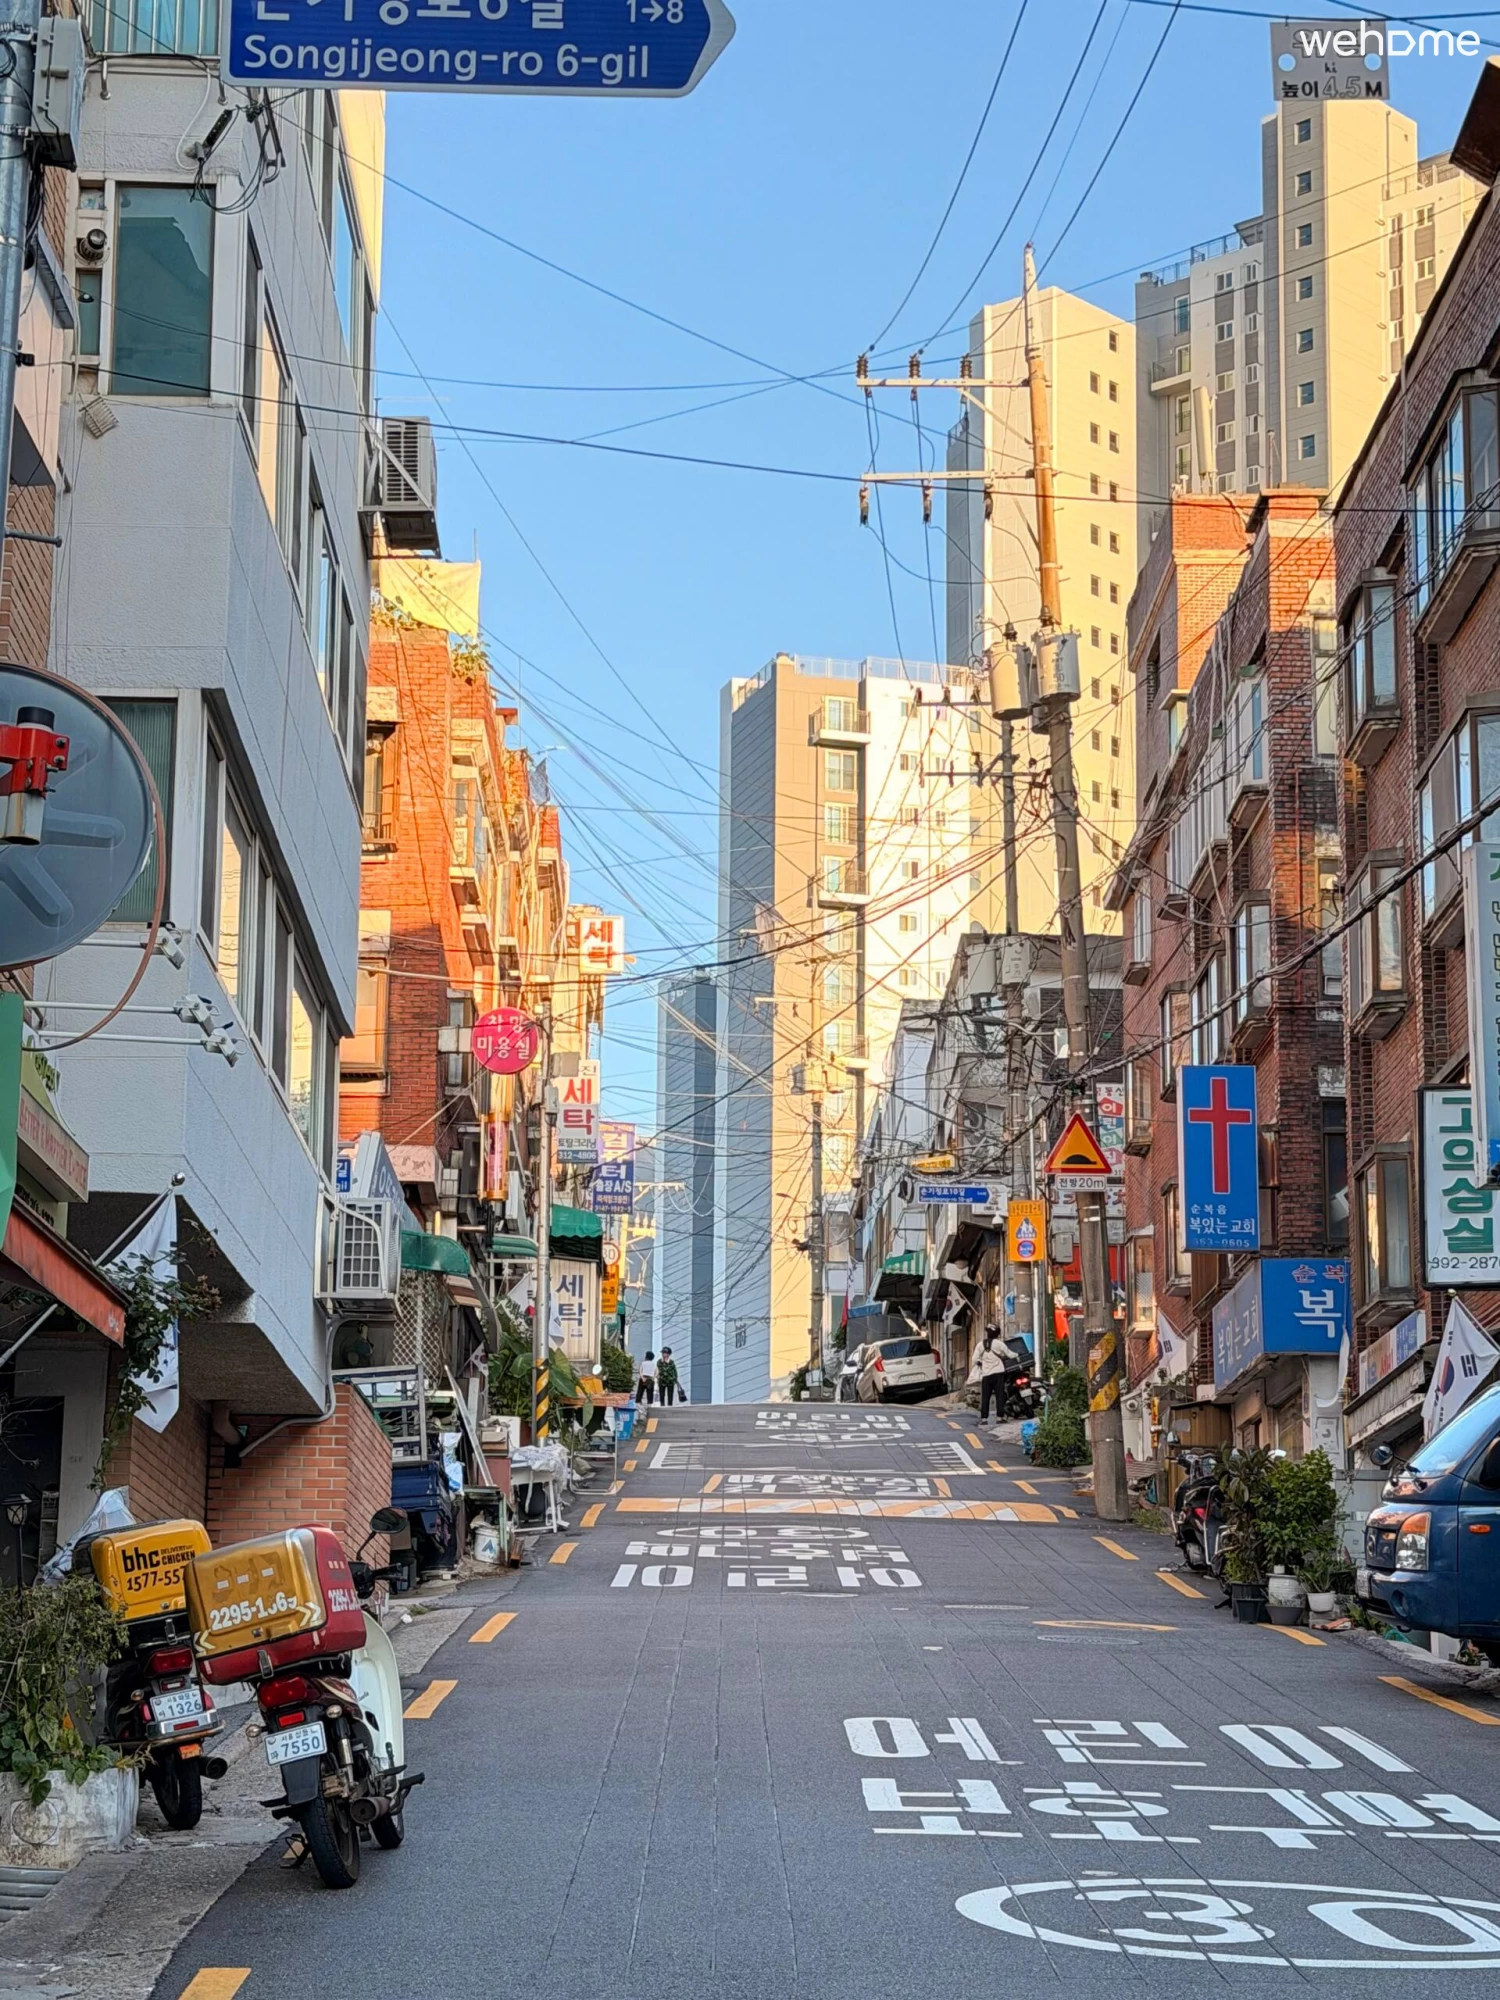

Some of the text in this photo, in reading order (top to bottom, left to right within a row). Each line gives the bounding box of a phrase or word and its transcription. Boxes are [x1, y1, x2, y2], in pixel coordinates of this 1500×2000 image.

[244, 35, 649, 85] Songijeong-ro 6-gil
[1281, 76, 1382, 98] 높이 4.5 M
[583, 920, 617, 969] 세탁
[476, 1035, 531, 1060] 미용실
[562, 1078, 597, 1136] 세탁
[1190, 1203, 1228, 1215] 순복음
[1430, 1256, 1500, 1270] 392-287
[555, 1274, 587, 1327] 세탁
[1293, 1289, 1343, 1339] 복
[121, 1546, 161, 1574] bhc
[161, 1550, 196, 1566] CHICKEN
[625, 1541, 912, 1562] 보호구역
[611, 1563, 923, 1588] 어린이
[168, 1699, 202, 1717] 1326
[280, 1735, 321, 1758] 7550
[843, 1716, 1420, 1773] 어린이
[860, 1777, 1500, 1849] 보호구역
[1073, 1889, 1500, 1953] 30
